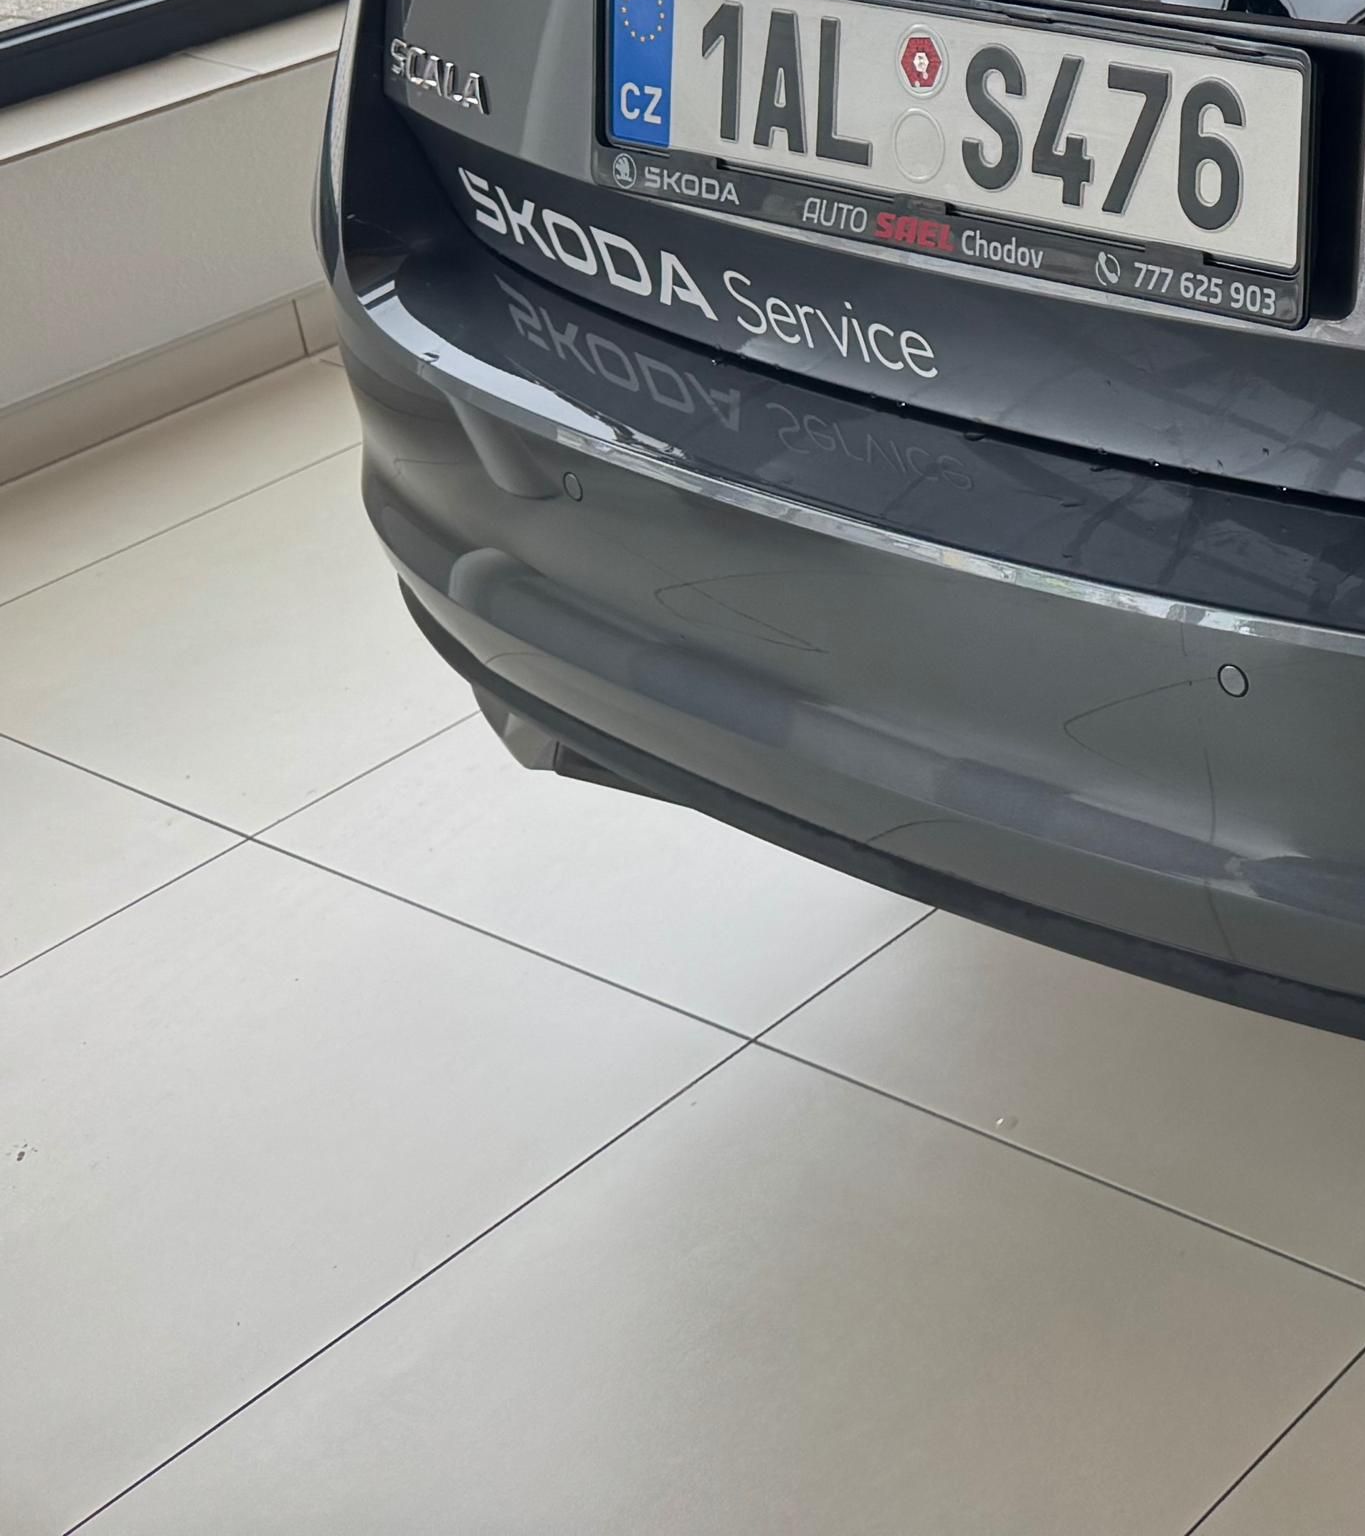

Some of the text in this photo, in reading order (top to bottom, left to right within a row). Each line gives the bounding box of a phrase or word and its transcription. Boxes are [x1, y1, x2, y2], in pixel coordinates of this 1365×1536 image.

[390, 38, 490, 115] SCALA
[620, 81, 663, 125] CZ
[700, 1, 1246, 233] 1AL S476
[802, 197, 1044, 270] AUTO SAEL Chodov
[724, 269, 939, 378] Service
[1133, 262, 1277, 316] 777 625 903
